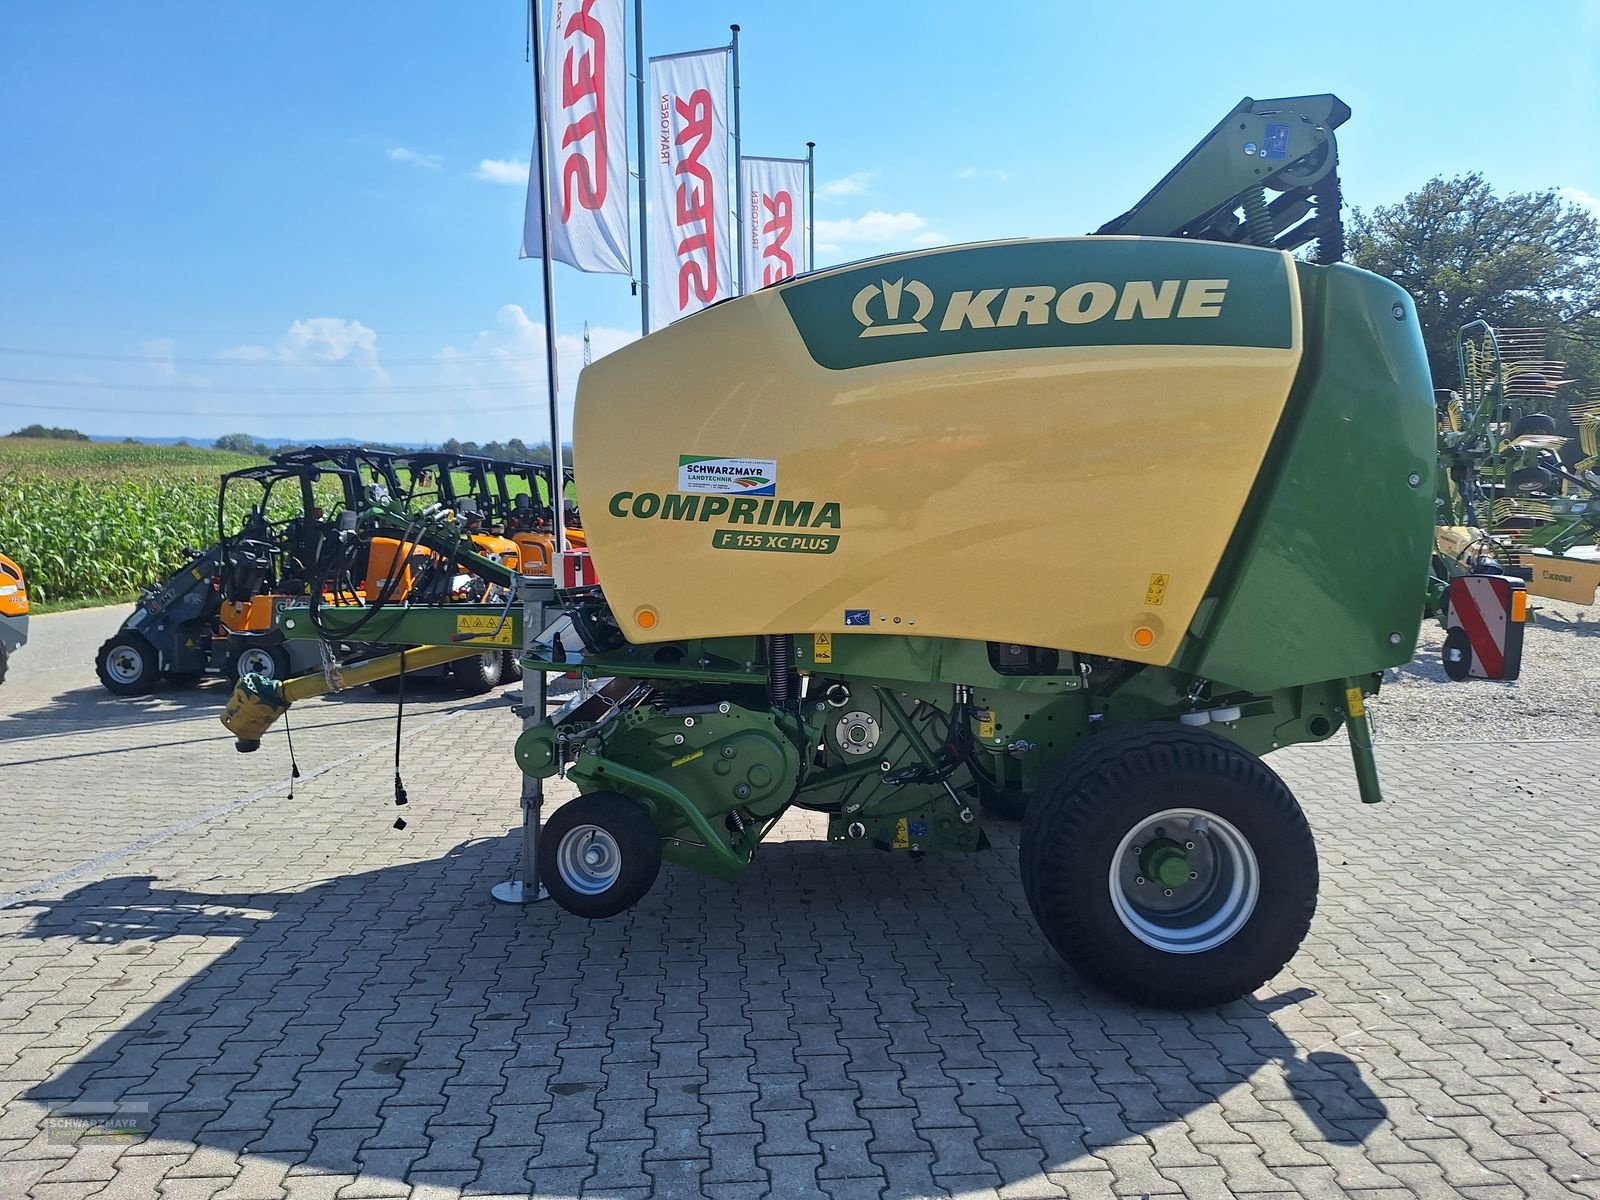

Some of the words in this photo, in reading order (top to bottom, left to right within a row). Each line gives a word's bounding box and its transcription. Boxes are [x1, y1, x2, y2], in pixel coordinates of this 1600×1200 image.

[939, 279, 1230, 332] KRONE
[687, 464, 763, 476] SCHWARZMAYR
[688, 475, 732, 483] LANDTECHNIK
[608, 491, 842, 529] COMPRIMA
[721, 534, 731, 546] F
[736, 534, 763, 547] 155
[766, 536, 789, 548] XC
[790, 538, 830, 550] PLUS
